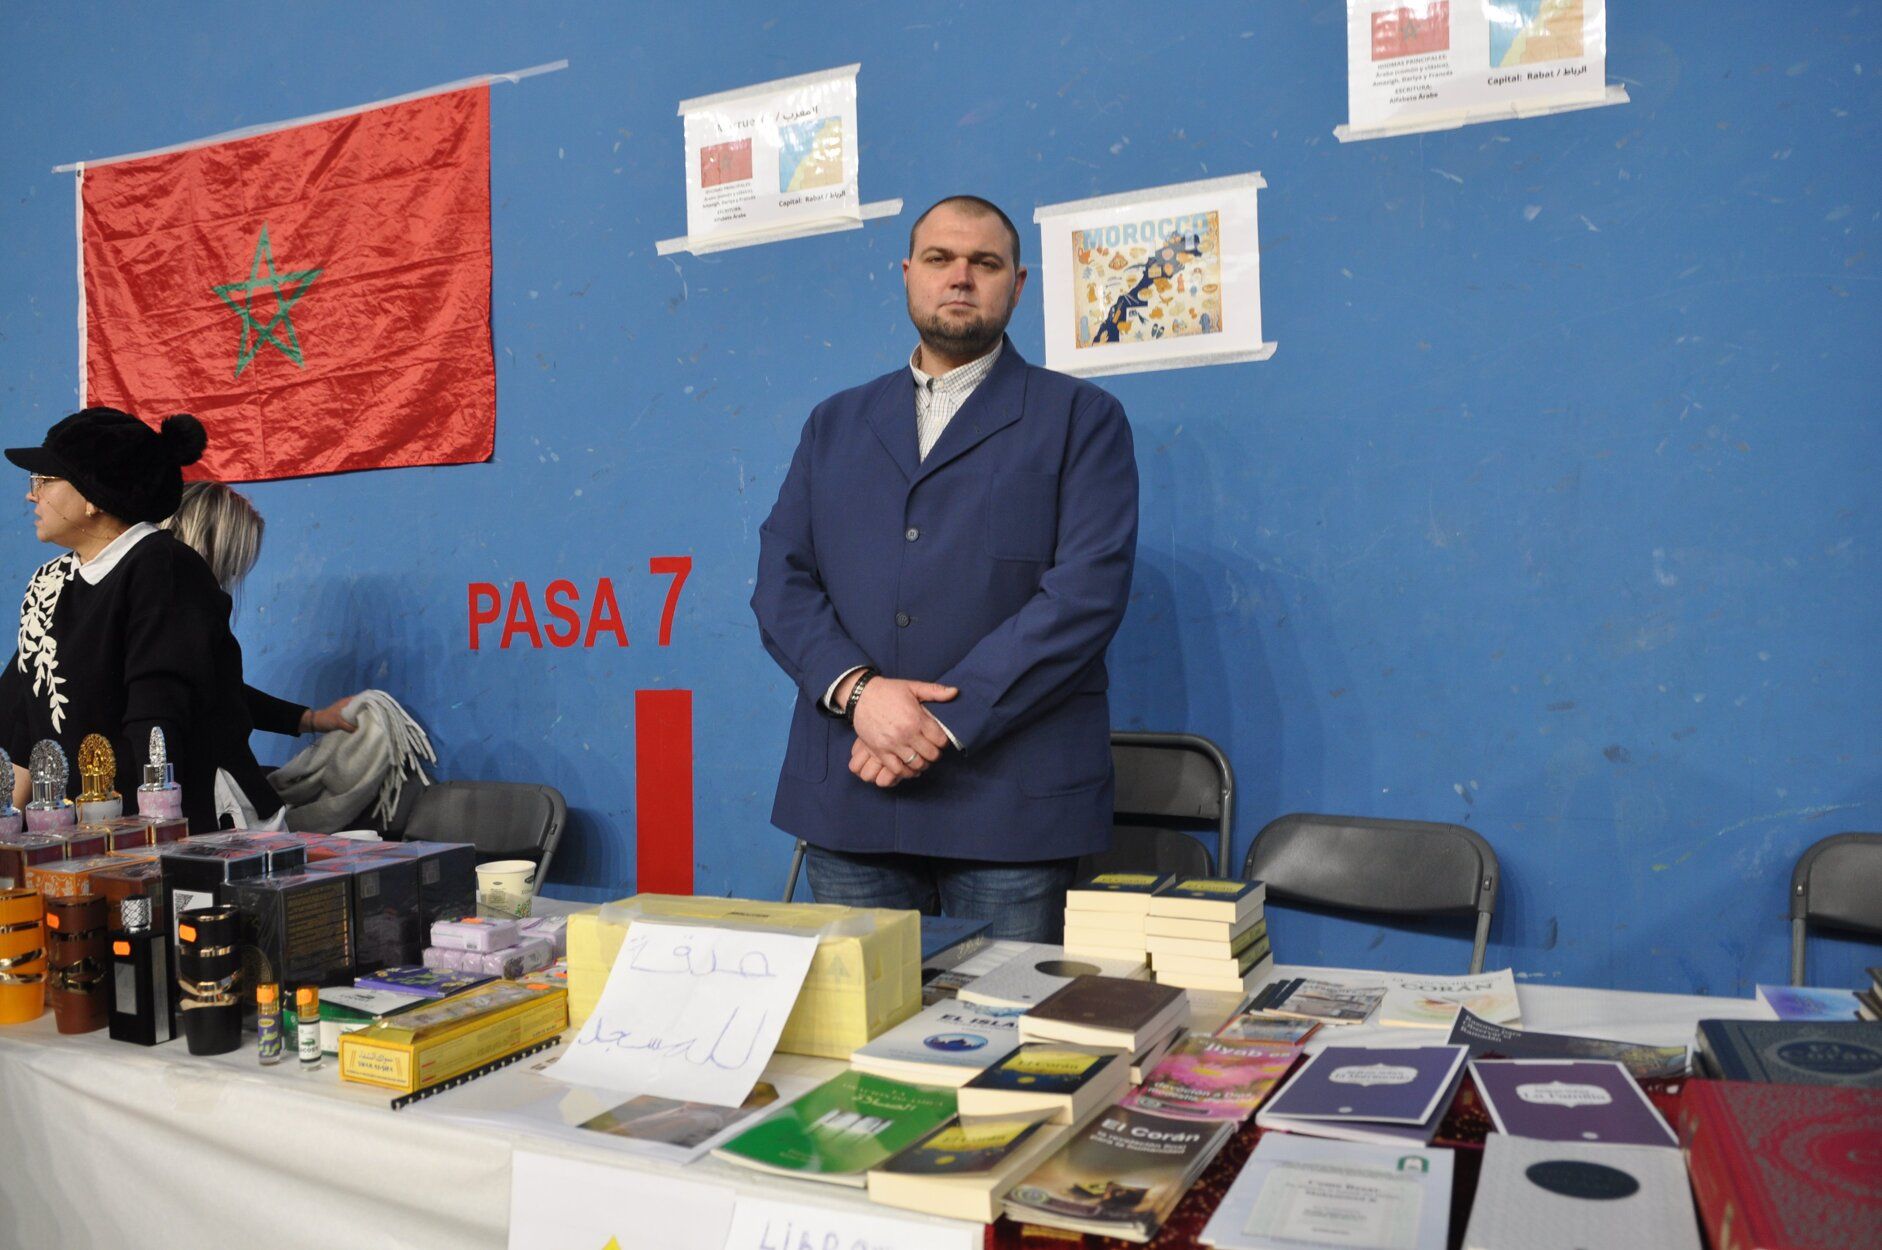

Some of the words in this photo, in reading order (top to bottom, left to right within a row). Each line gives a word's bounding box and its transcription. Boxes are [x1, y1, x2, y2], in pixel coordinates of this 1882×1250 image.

[1488, 74, 1522, 86] Capital:
[1527, 70, 1554, 80] Rabat
[779, 197, 802, 208] Capital:
[1082, 212, 1209, 251] MOROCCO
[467, 576, 630, 651] PASA
[648, 555, 693, 647] 7
[941, 1013, 963, 1022] EL
[970, 1017, 1019, 1029] ISLA
[1101, 1118, 1127, 1133] El
[1131, 1125, 1200, 1143] Corán
